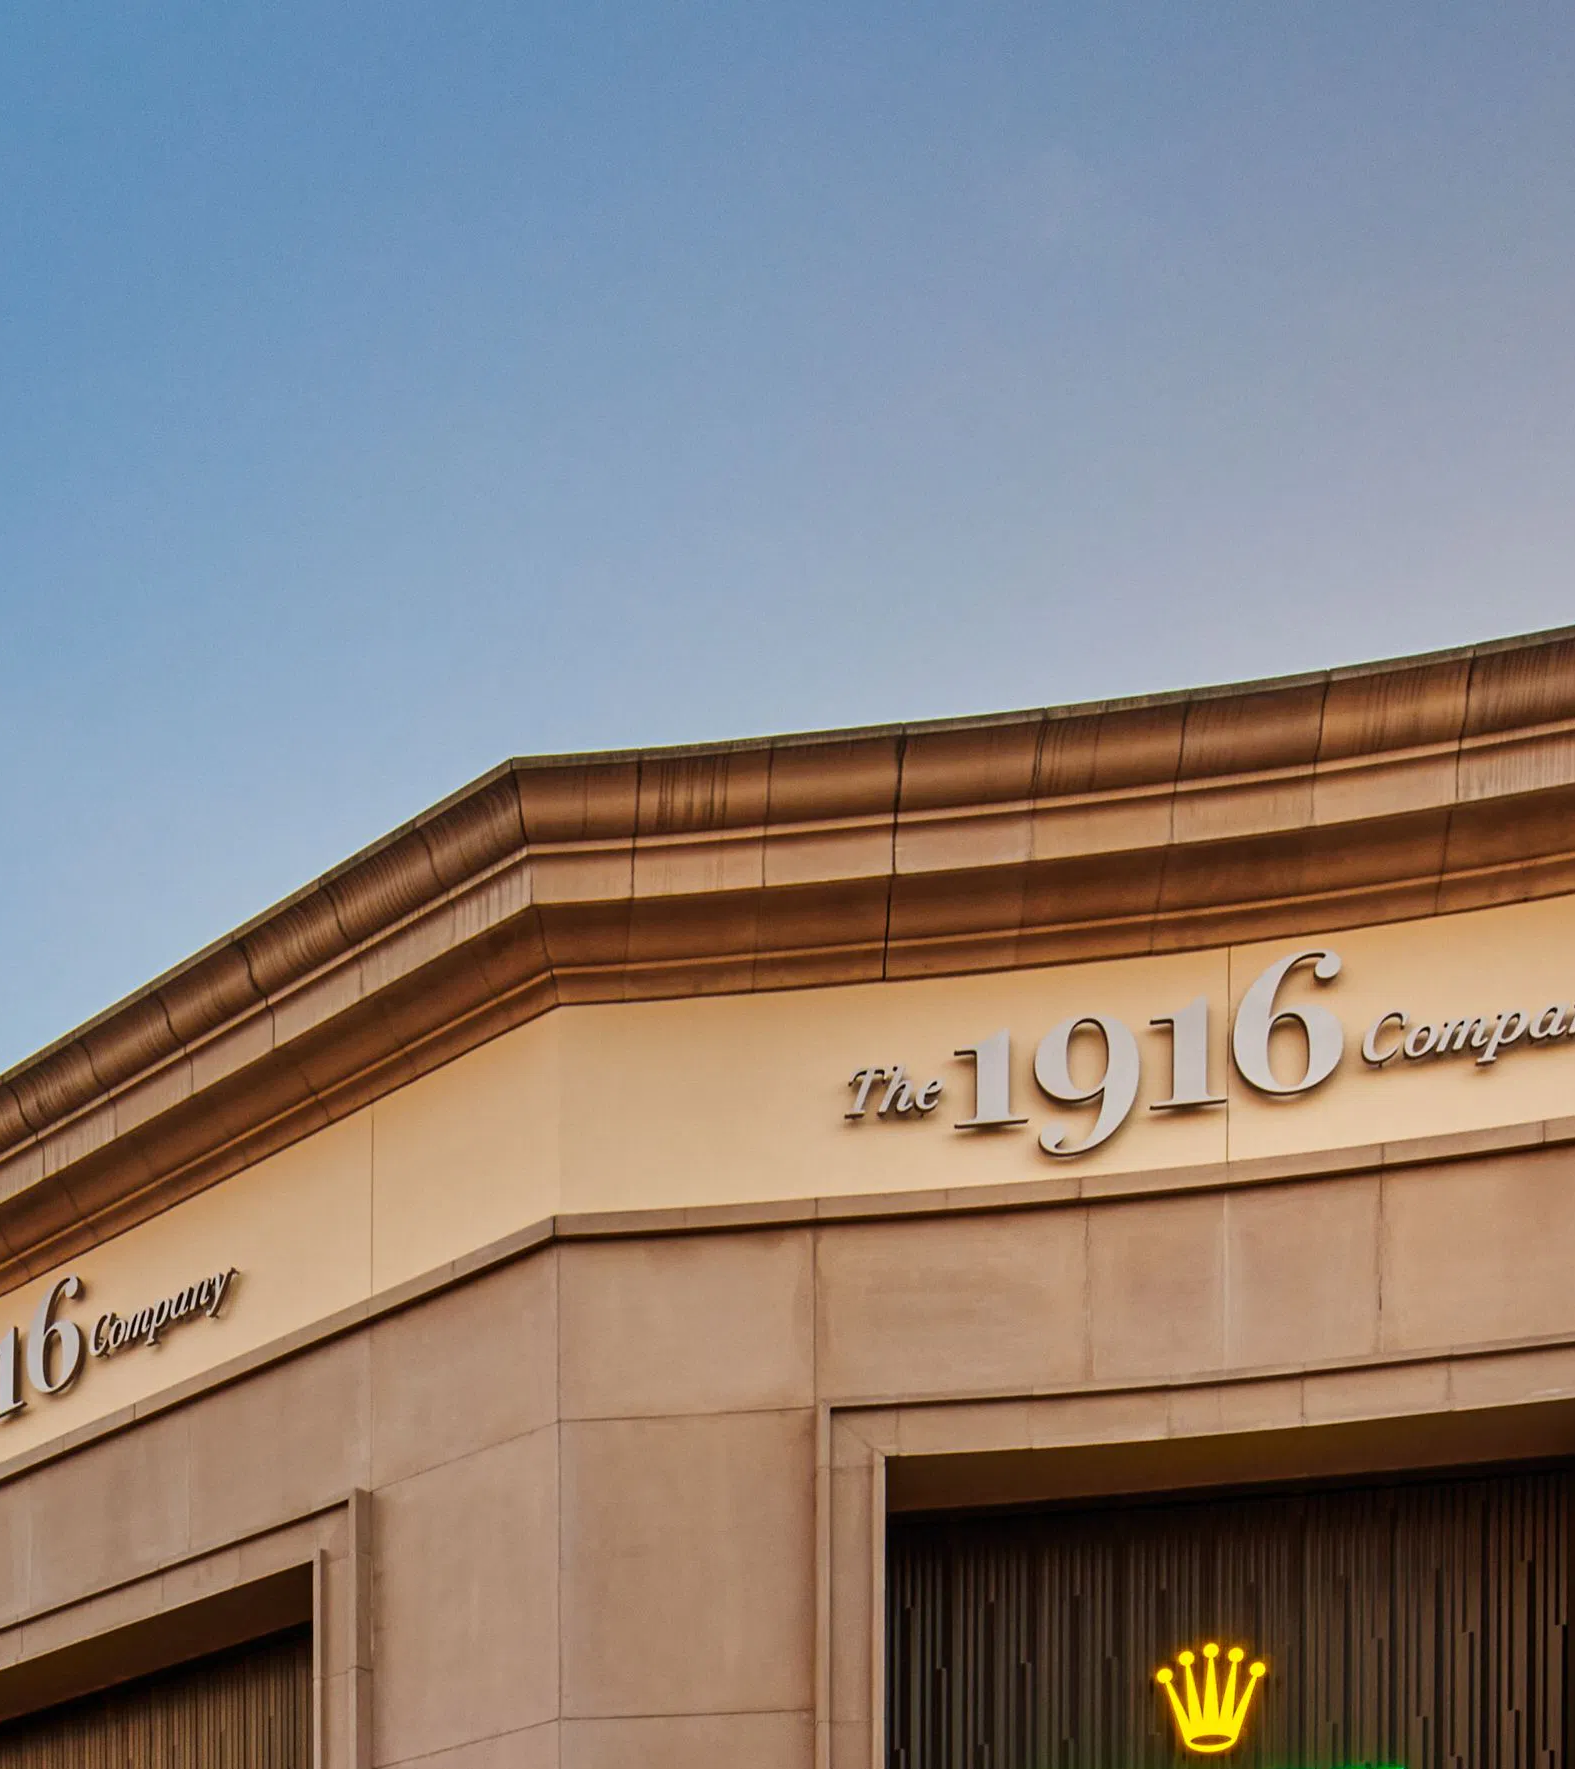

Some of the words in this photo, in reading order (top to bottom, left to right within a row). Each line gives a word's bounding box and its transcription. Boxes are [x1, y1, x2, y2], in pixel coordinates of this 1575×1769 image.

[845, 1064, 943, 1120] The
[953, 949, 1344, 1158] 1916
[89, 1266, 240, 1358] Company
